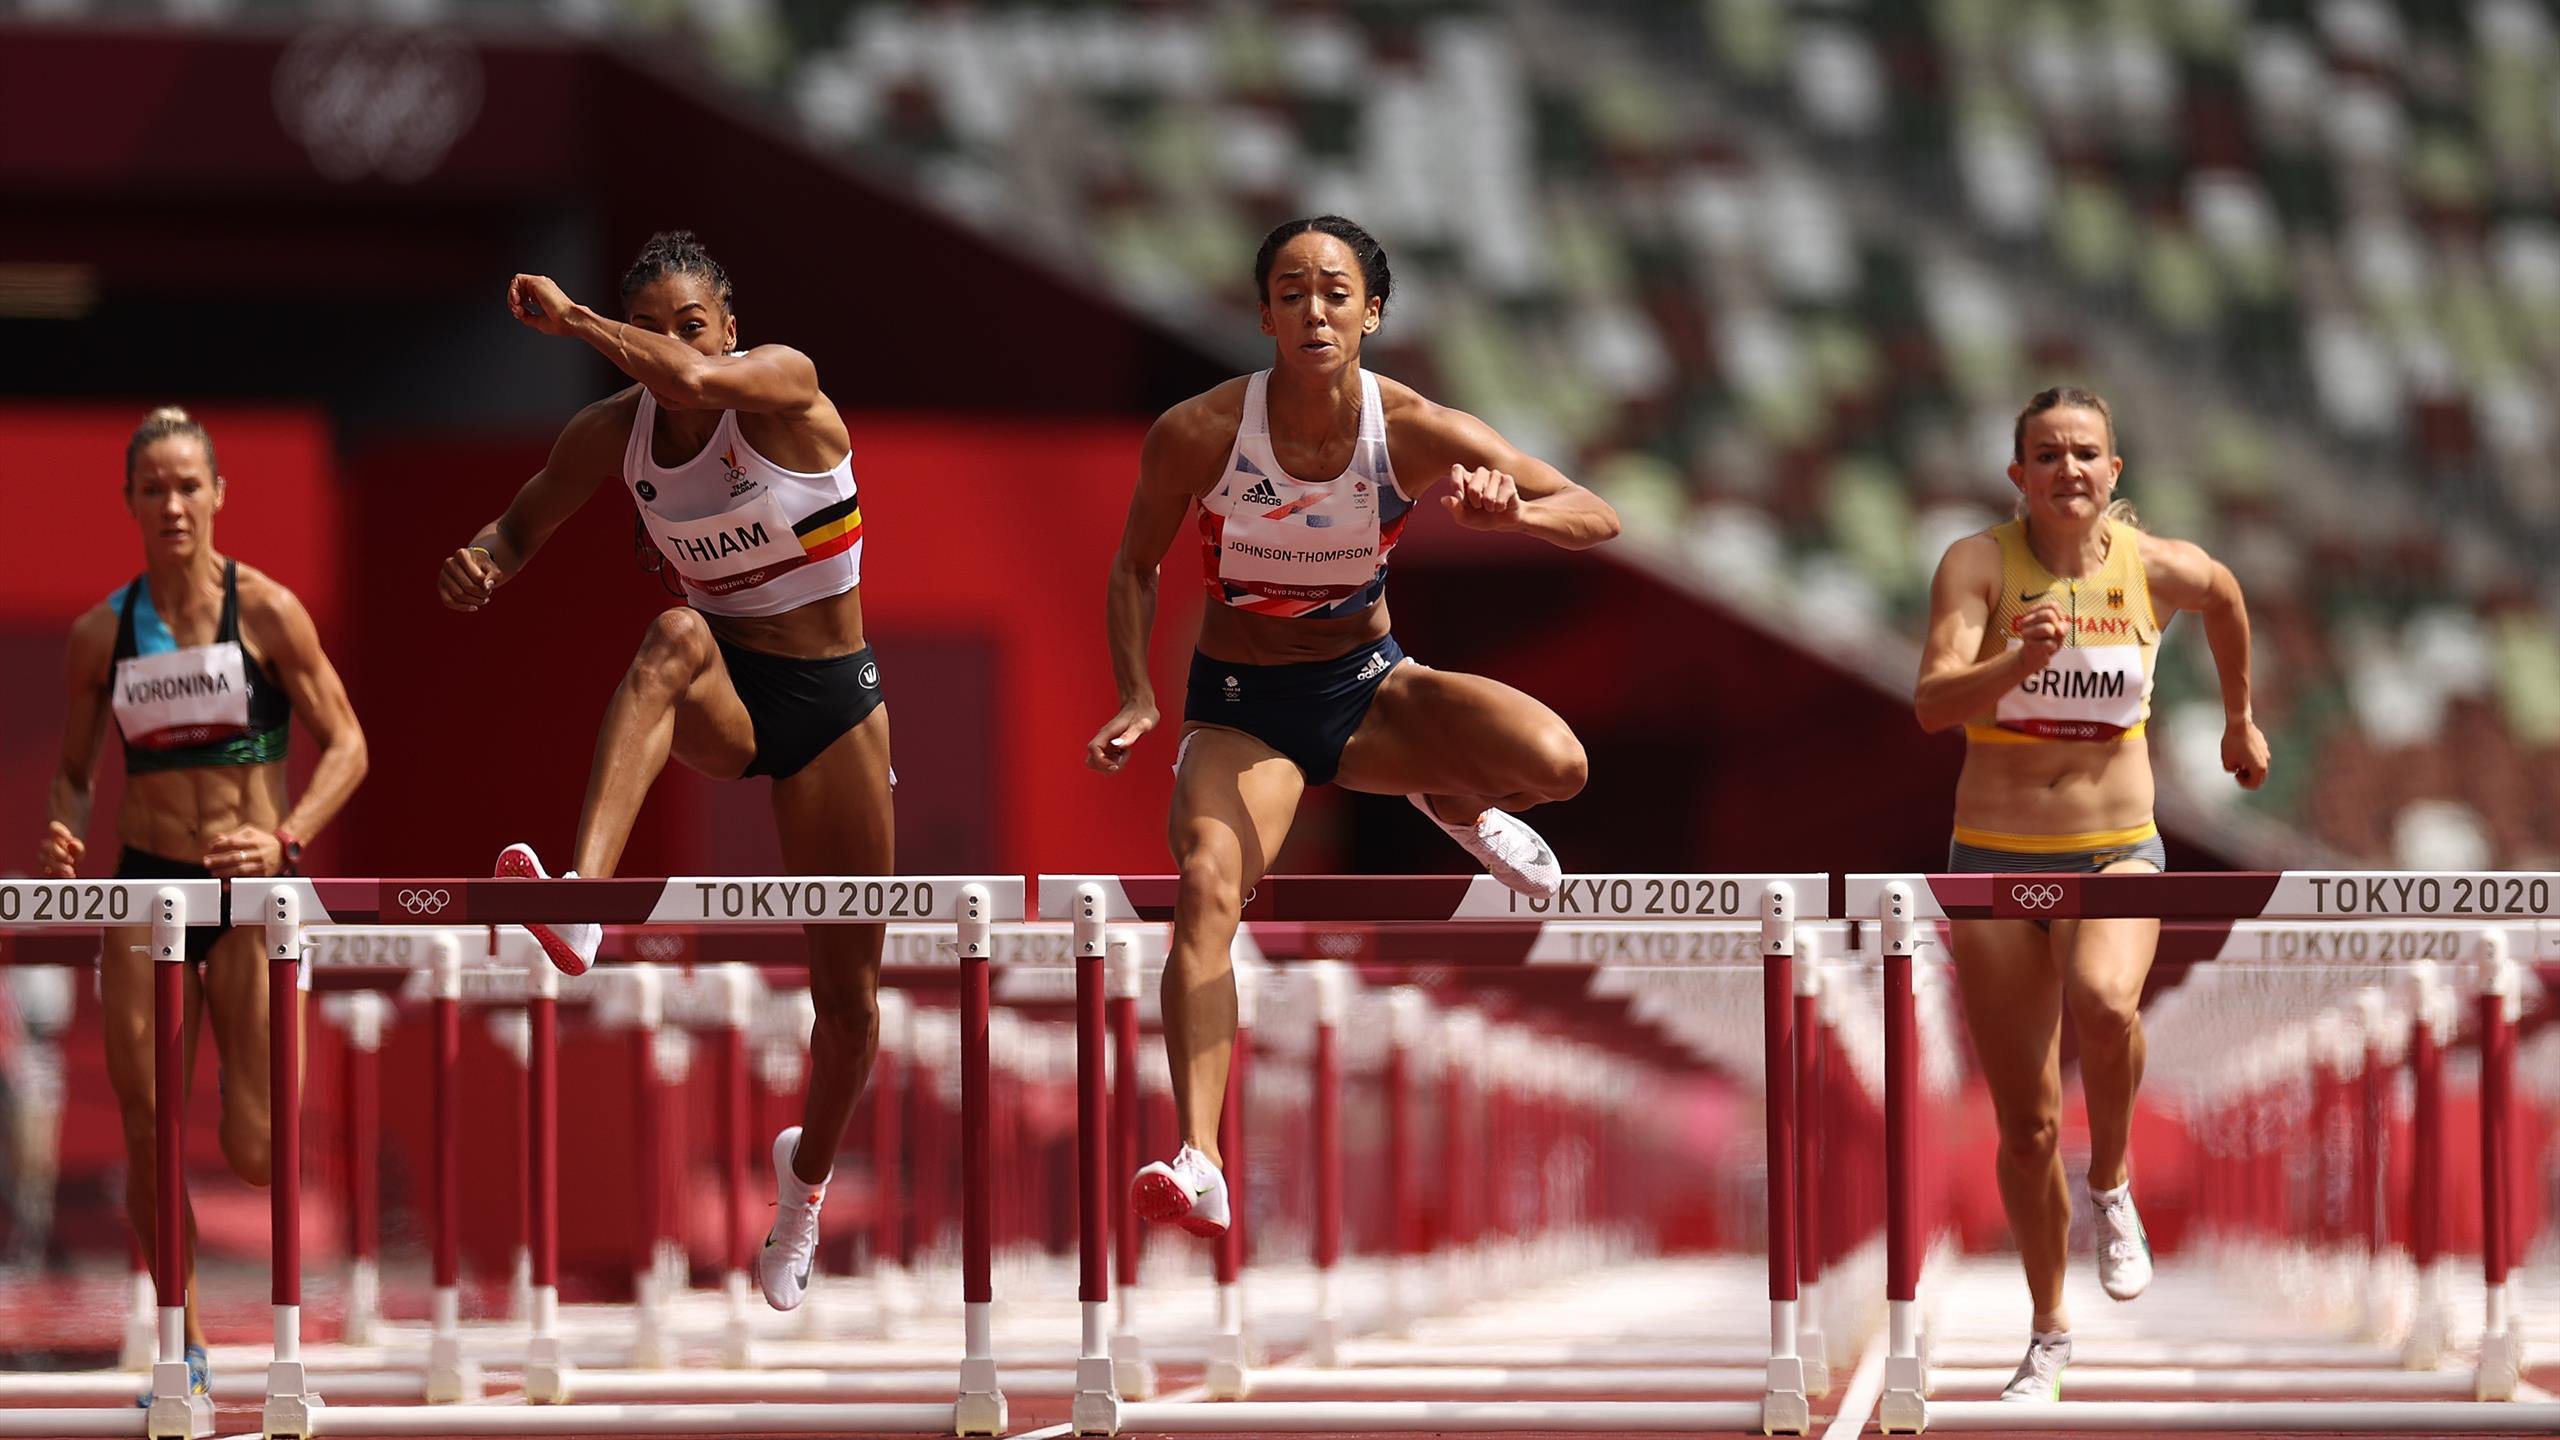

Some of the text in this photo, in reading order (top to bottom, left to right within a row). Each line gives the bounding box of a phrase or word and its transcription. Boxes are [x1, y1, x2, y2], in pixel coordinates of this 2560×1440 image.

[1242, 493, 1282, 506] adidas
[667, 521, 770, 562] THIAM
[1228, 541, 1373, 563] JOHNSON-THOMPSON
[2010, 615, 2131, 635] GMANY
[1357, 660, 1391, 681] adidas
[2021, 668, 2124, 698] GRIMM
[124, 672, 230, 706] VORONINA
[33, 885, 128, 920] 2020
[695, 882, 933, 917] TOKYO 2020
[1645, 879, 1740, 914] 2020
[2309, 878, 2549, 913] TOKYO 2020
[1012, 934, 1073, 963] 202
[1570, 932, 1679, 961] TOKYO
[2255, 931, 2460, 961] TOKYO 2020
